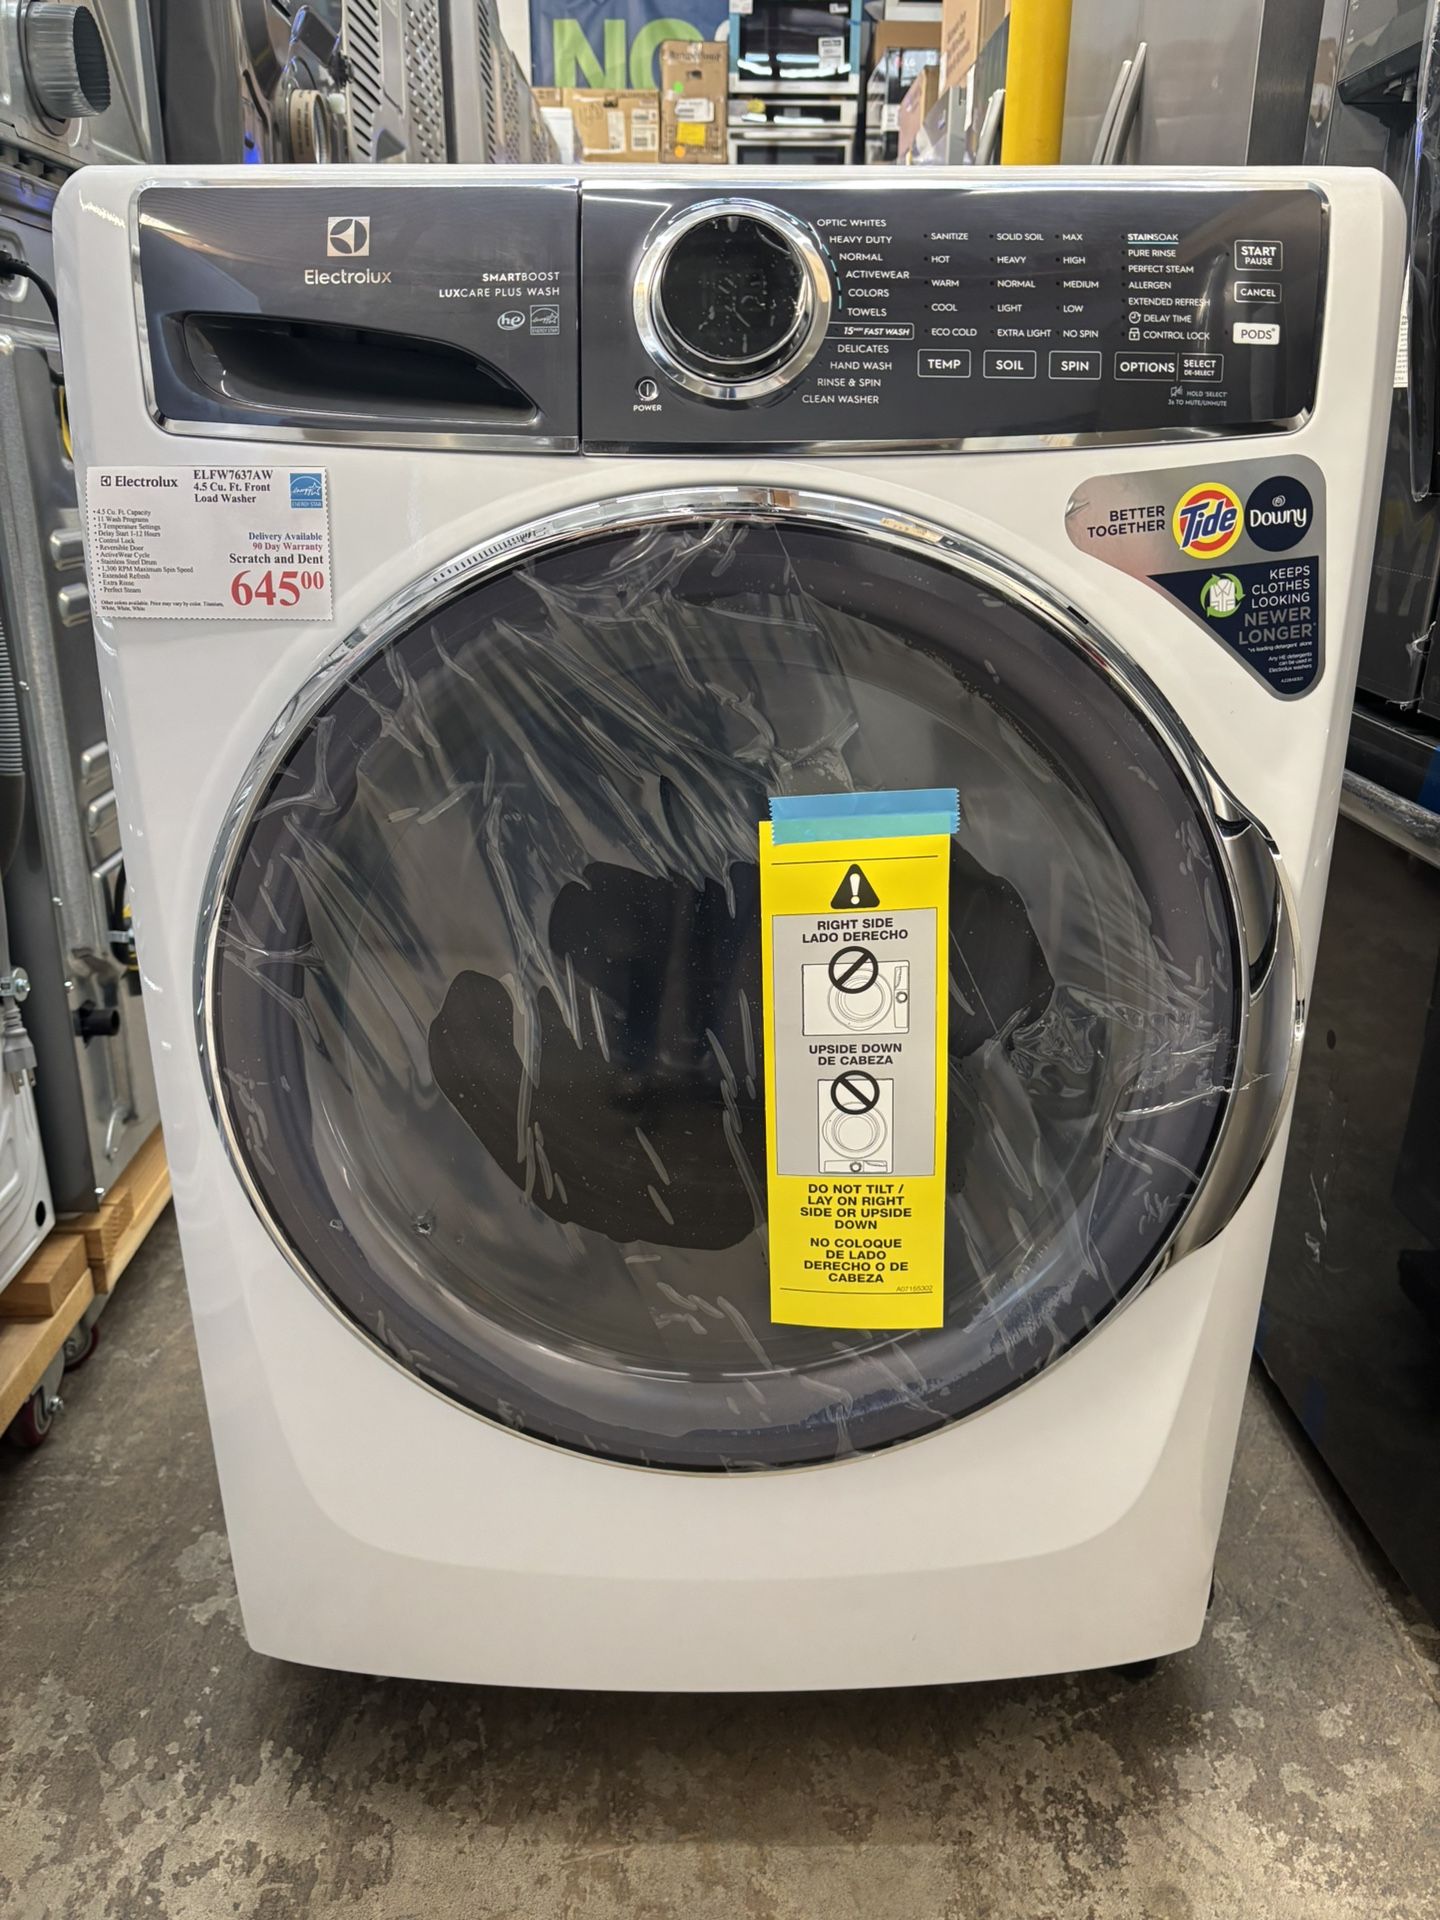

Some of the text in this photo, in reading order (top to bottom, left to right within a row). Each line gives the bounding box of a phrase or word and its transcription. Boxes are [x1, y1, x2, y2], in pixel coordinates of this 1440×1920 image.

[817, 218, 887, 228] OPTIC WHITES
[829, 235, 893, 244] HEAVY DUTY
[930, 232, 969, 241] SANITIZE
[996, 232, 1044, 241] SOLID SOIL
[1062, 233, 1083, 241] MAX
[1127, 233, 1179, 241] STAINSOAK
[1127, 249, 1176, 257] PURE RINSE
[1240, 246, 1277, 256] START
[839, 252, 884, 261] NORMAL
[931, 255, 950, 263] HOT
[997, 255, 1027, 264] HEAVY
[1062, 256, 1086, 264] HIGH
[1244, 257, 1273, 266] PAUSE
[1128, 265, 1194, 273] PERFECT STEAM
[304, 268, 392, 285] Electrolux
[482, 271, 560, 282] SMARTBOOST
[845, 270, 910, 279] ACTIVEWEAR
[931, 279, 960, 288] WARM
[997, 279, 1036, 288] NORMAL
[1063, 280, 1099, 289] MEDIUM
[1128, 281, 1171, 290] ALLERGEN
[439, 287, 560, 298] LUXCARE PLUS WASH
[848, 288, 889, 297] COLORS
[1240, 288, 1276, 297] CANCEL
[931, 303, 958, 312] COOL
[997, 303, 1022, 312] LIGHT
[1128, 298, 1211, 307] EXTENDED REFRESH
[847, 307, 887, 317] TOWELS
[1063, 304, 1084, 313] LOW
[1143, 314, 1192, 323] DELAY TIME
[864, 328, 883, 336] FAST
[885, 328, 910, 336] WASH
[931, 328, 978, 337] ECO COLD
[997, 328, 1052, 338] EXTRA LIGHT
[1062, 329, 1099, 338] NO SPIN
[1143, 331, 1210, 340] CONTROL LOCK
[837, 344, 889, 354] DELICATES
[829, 361, 893, 371] HAND WASH
[927, 359, 961, 370] TEMP
[995, 360, 1024, 371] SOIL
[1060, 360, 1090, 371] SPIN
[1119, 361, 1175, 373] OPTIONS
[1183, 359, 1216, 368] SELECT
[817, 378, 882, 387] RINSE & SPIN
[801, 394, 880, 404] CLEAN WASHER
[1186, 390, 1204, 398] HOLD
[633, 404, 662, 412] POWER
[193, 469, 273, 481] ELFW7637AW
[115, 475, 178, 488] Electrolux
[194, 482, 271, 492] 4.5 Cu. Ft. Front
[195, 494, 257, 504] Load Washer
[126, 509, 151, 517] Capacity
[1109, 505, 1166, 522] BETTER
[1249, 506, 1307, 528] Downy
[1087, 519, 1166, 538] TOGETHER
[1178, 498, 1238, 550] Tide
[249, 532, 323, 542] Delivery Available
[252, 542, 323, 552] 90 Day Warranty
[229, 554, 324, 565] Scratch and Dent
[1269, 565, 1311, 579] KEEPS
[1251, 580, 1311, 595] CLOTHES
[1251, 594, 1311, 609] LOOKING
[1244, 606, 1311, 627] NEWER
[1287, 652, 1312, 660] detergents
[817, 917, 894, 931] RIGHT SIDE
[802, 929, 908, 944] LADO DERECHO
[809, 1043, 903, 1055] UPSIDE DOWN
[818, 1055, 893, 1066] DE CABEZA
[808, 1183, 904, 1194] DO NOT TILT /
[807, 1195, 904, 1206] LAY ON RIGHT
[800, 1207, 912, 1218] SIDE OR UPSIDE
[834, 1219, 878, 1230] DOWN
[810, 1237, 902, 1249] NO COLOQUE
[825, 1250, 886, 1260] DE LADO
[804, 1260, 909, 1272] DERECHO O DE
[828, 1273, 884, 1283] CABEZA
